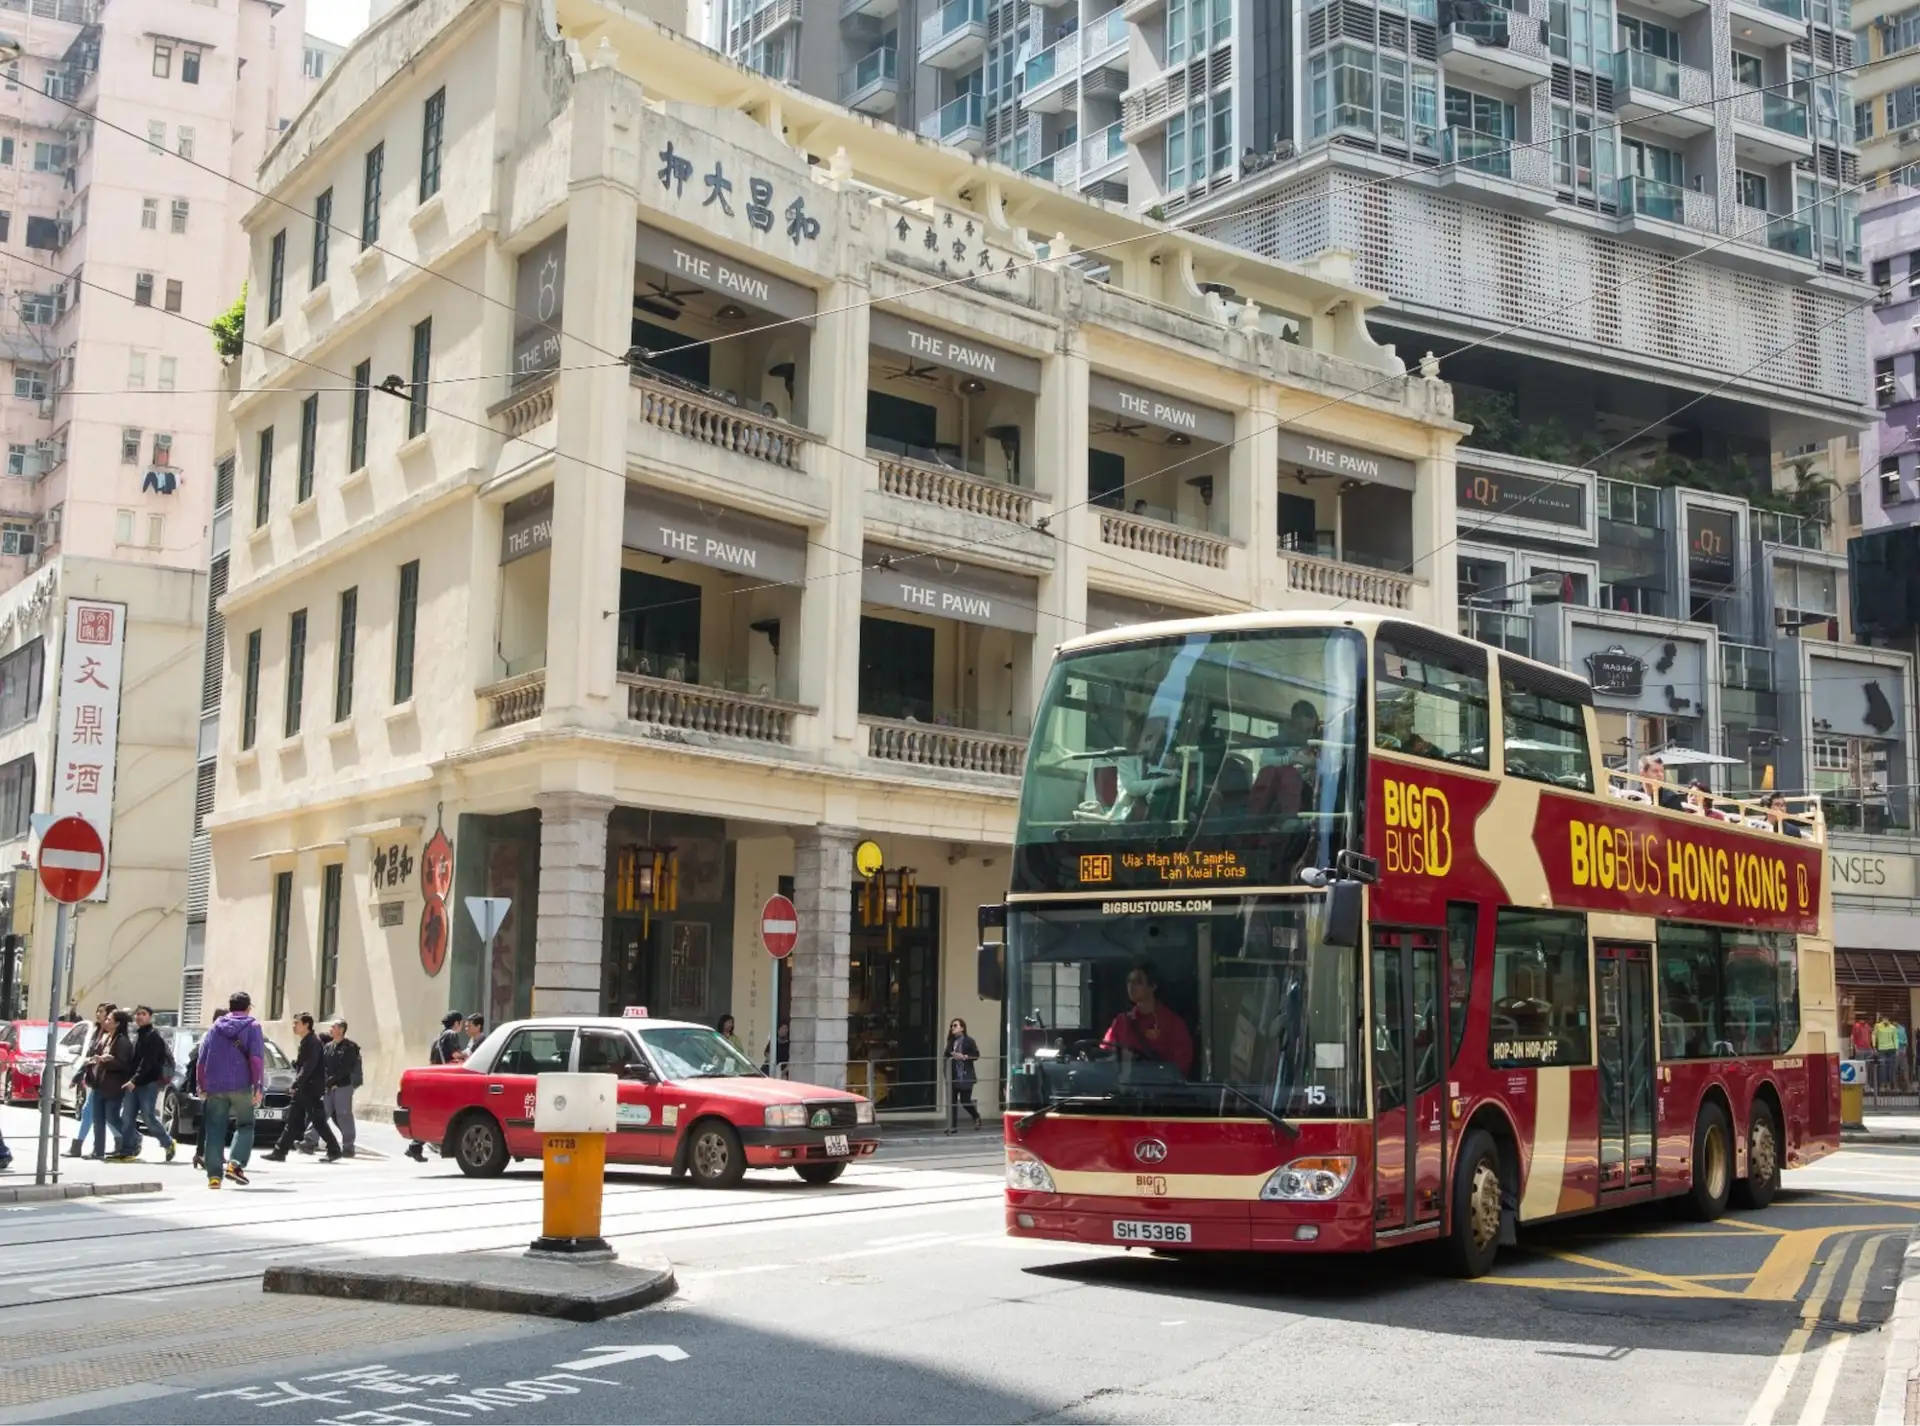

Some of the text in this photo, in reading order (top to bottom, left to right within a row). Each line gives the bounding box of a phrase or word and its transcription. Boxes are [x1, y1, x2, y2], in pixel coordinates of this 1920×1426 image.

[673, 249, 769, 301] THE PAWN
[518, 345, 542, 373] THE
[908, 331, 996, 373] THE PAWN
[1119, 391, 1196, 429] THE PAWN
[1306, 445, 1379, 477] THE PAWN
[508, 530, 530, 553] THE
[659, 527, 757, 569] THE PAWN
[900, 584, 991, 618] THE PAWN
[66, 656, 109, 818] 文鼎酒
[1384, 779, 1422, 829] BIG
[1081, 855, 1112, 881] RED
[1146, 853, 1169, 866] Man
[1173, 852, 1189, 865] Mo
[1386, 830, 1424, 874] BUS
[1160, 864, 1247, 880] Lan Kwai Fong
[1667, 838, 1730, 906] HONG
[1734, 851, 1788, 912] KONG
[1828, 855, 1886, 886] NSES
[1102, 900, 1212, 914] BIGBUSTOURS.COM
[1494, 1040, 1558, 1060] HOP-ON HOP-OFF
[524, 1093, 536, 1106] 的
[1304, 1085, 1326, 1105] 15
[524, 1106, 536, 1119] TA
[1136, 1175, 1153, 1186] BIG
[1117, 1222, 1186, 1241] SH 5386
[316, 1373, 621, 1425] LOOK LE
